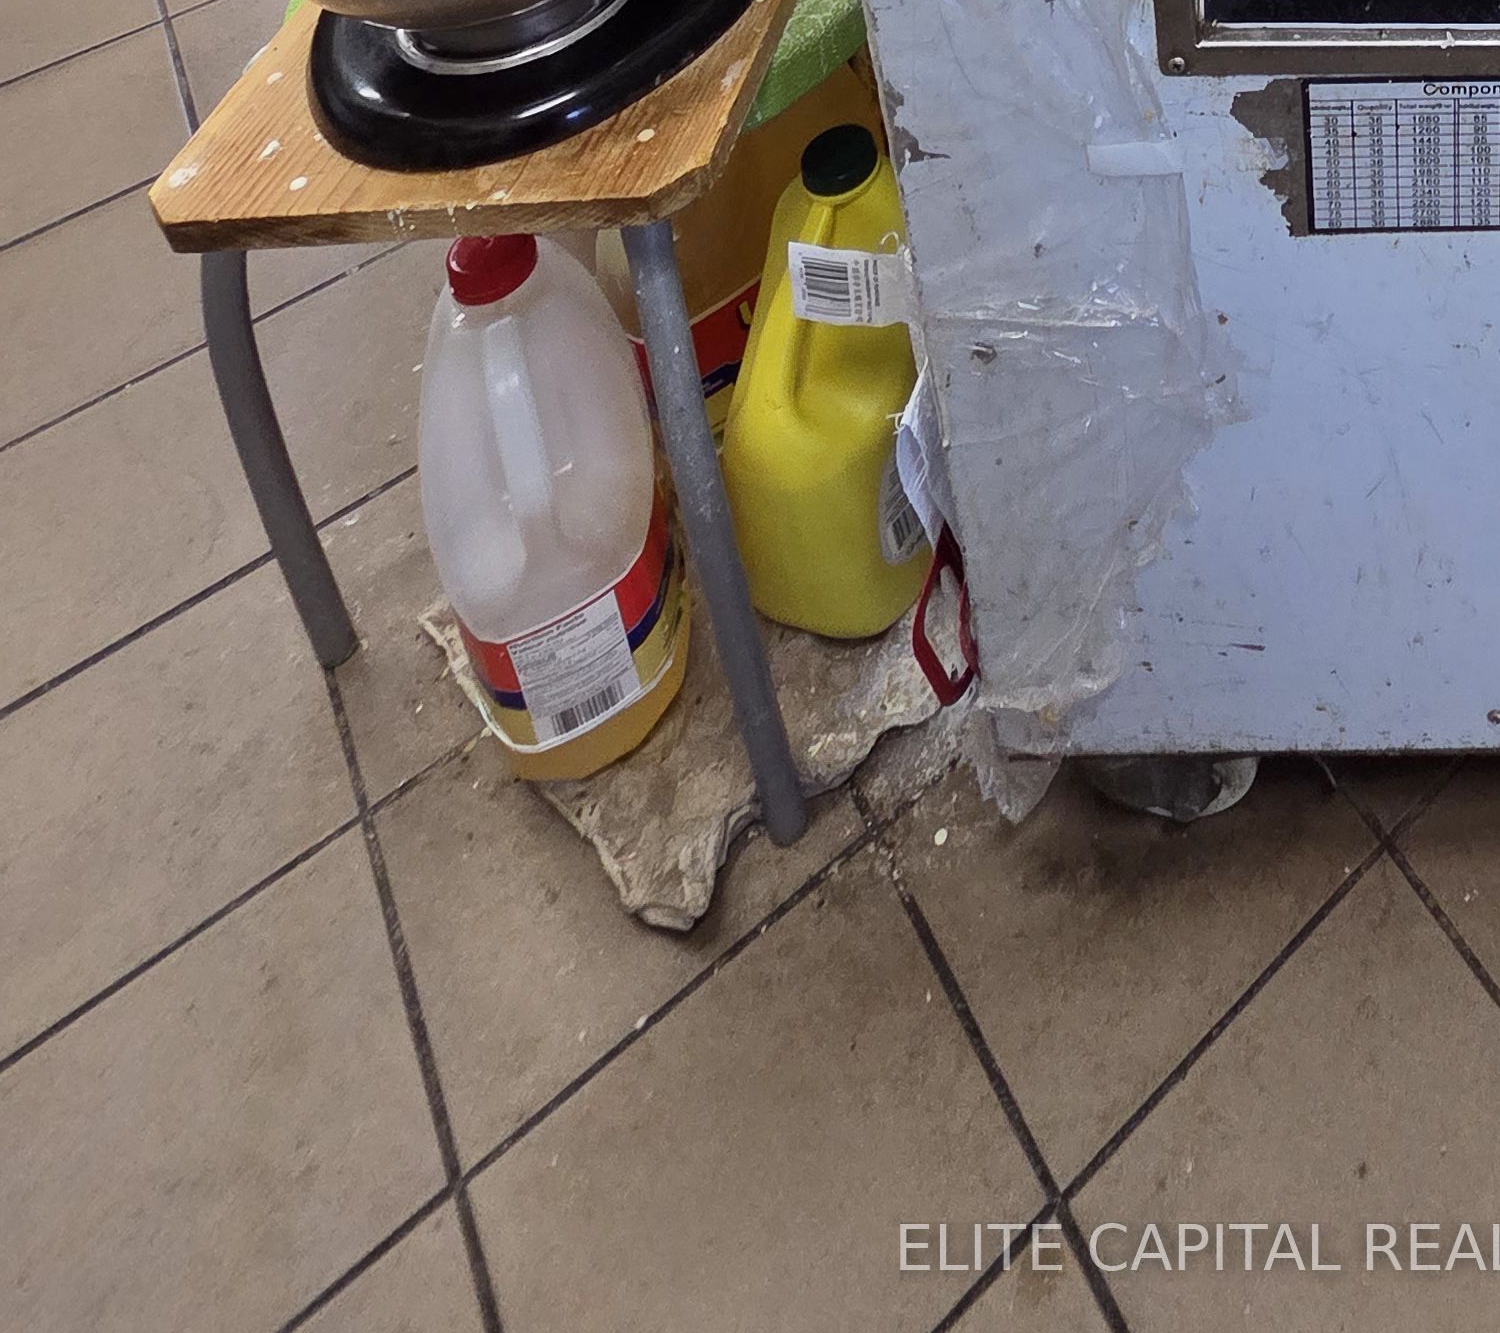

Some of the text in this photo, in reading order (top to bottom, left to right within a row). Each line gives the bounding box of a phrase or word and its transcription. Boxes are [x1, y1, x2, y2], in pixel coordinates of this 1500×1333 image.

[1324, 117, 1339, 125] 30
[1368, 117, 1383, 125] 36
[1473, 114, 1488, 123] 85
[1324, 127, 1339, 136] 35
[1368, 127, 1383, 135] 36
[1473, 125, 1488, 133] 90
[1324, 138, 1339, 147] 40
[1369, 138, 1383, 146] 36
[1473, 136, 1488, 144] 95
[1325, 148, 1340, 156] 45
[1369, 148, 1384, 156] 36
[1470, 146, 1491, 154] 100
[1325, 158, 1340, 167] 50
[1369, 158, 1384, 167] 36
[1470, 156, 1491, 165] 105
[1326, 169, 1341, 178] 55
[1370, 169, 1384, 177] 36
[1470, 167, 1491, 175] 110
[1326, 179, 1341, 188] 60
[1370, 179, 1384, 188] 36
[1470, 177, 1491, 185] 115
[1326, 190, 1341, 199] 65
[1370, 190, 1385, 198] 36
[1470, 187, 1491, 196] 120
[1327, 200, 1342, 209] 70
[1370, 200, 1385, 208] 36
[1470, 198, 1491, 207] 125
[1327, 210, 1342, 218] 75
[1371, 209, 1385, 218] 36
[1470, 208, 1491, 216] 130
